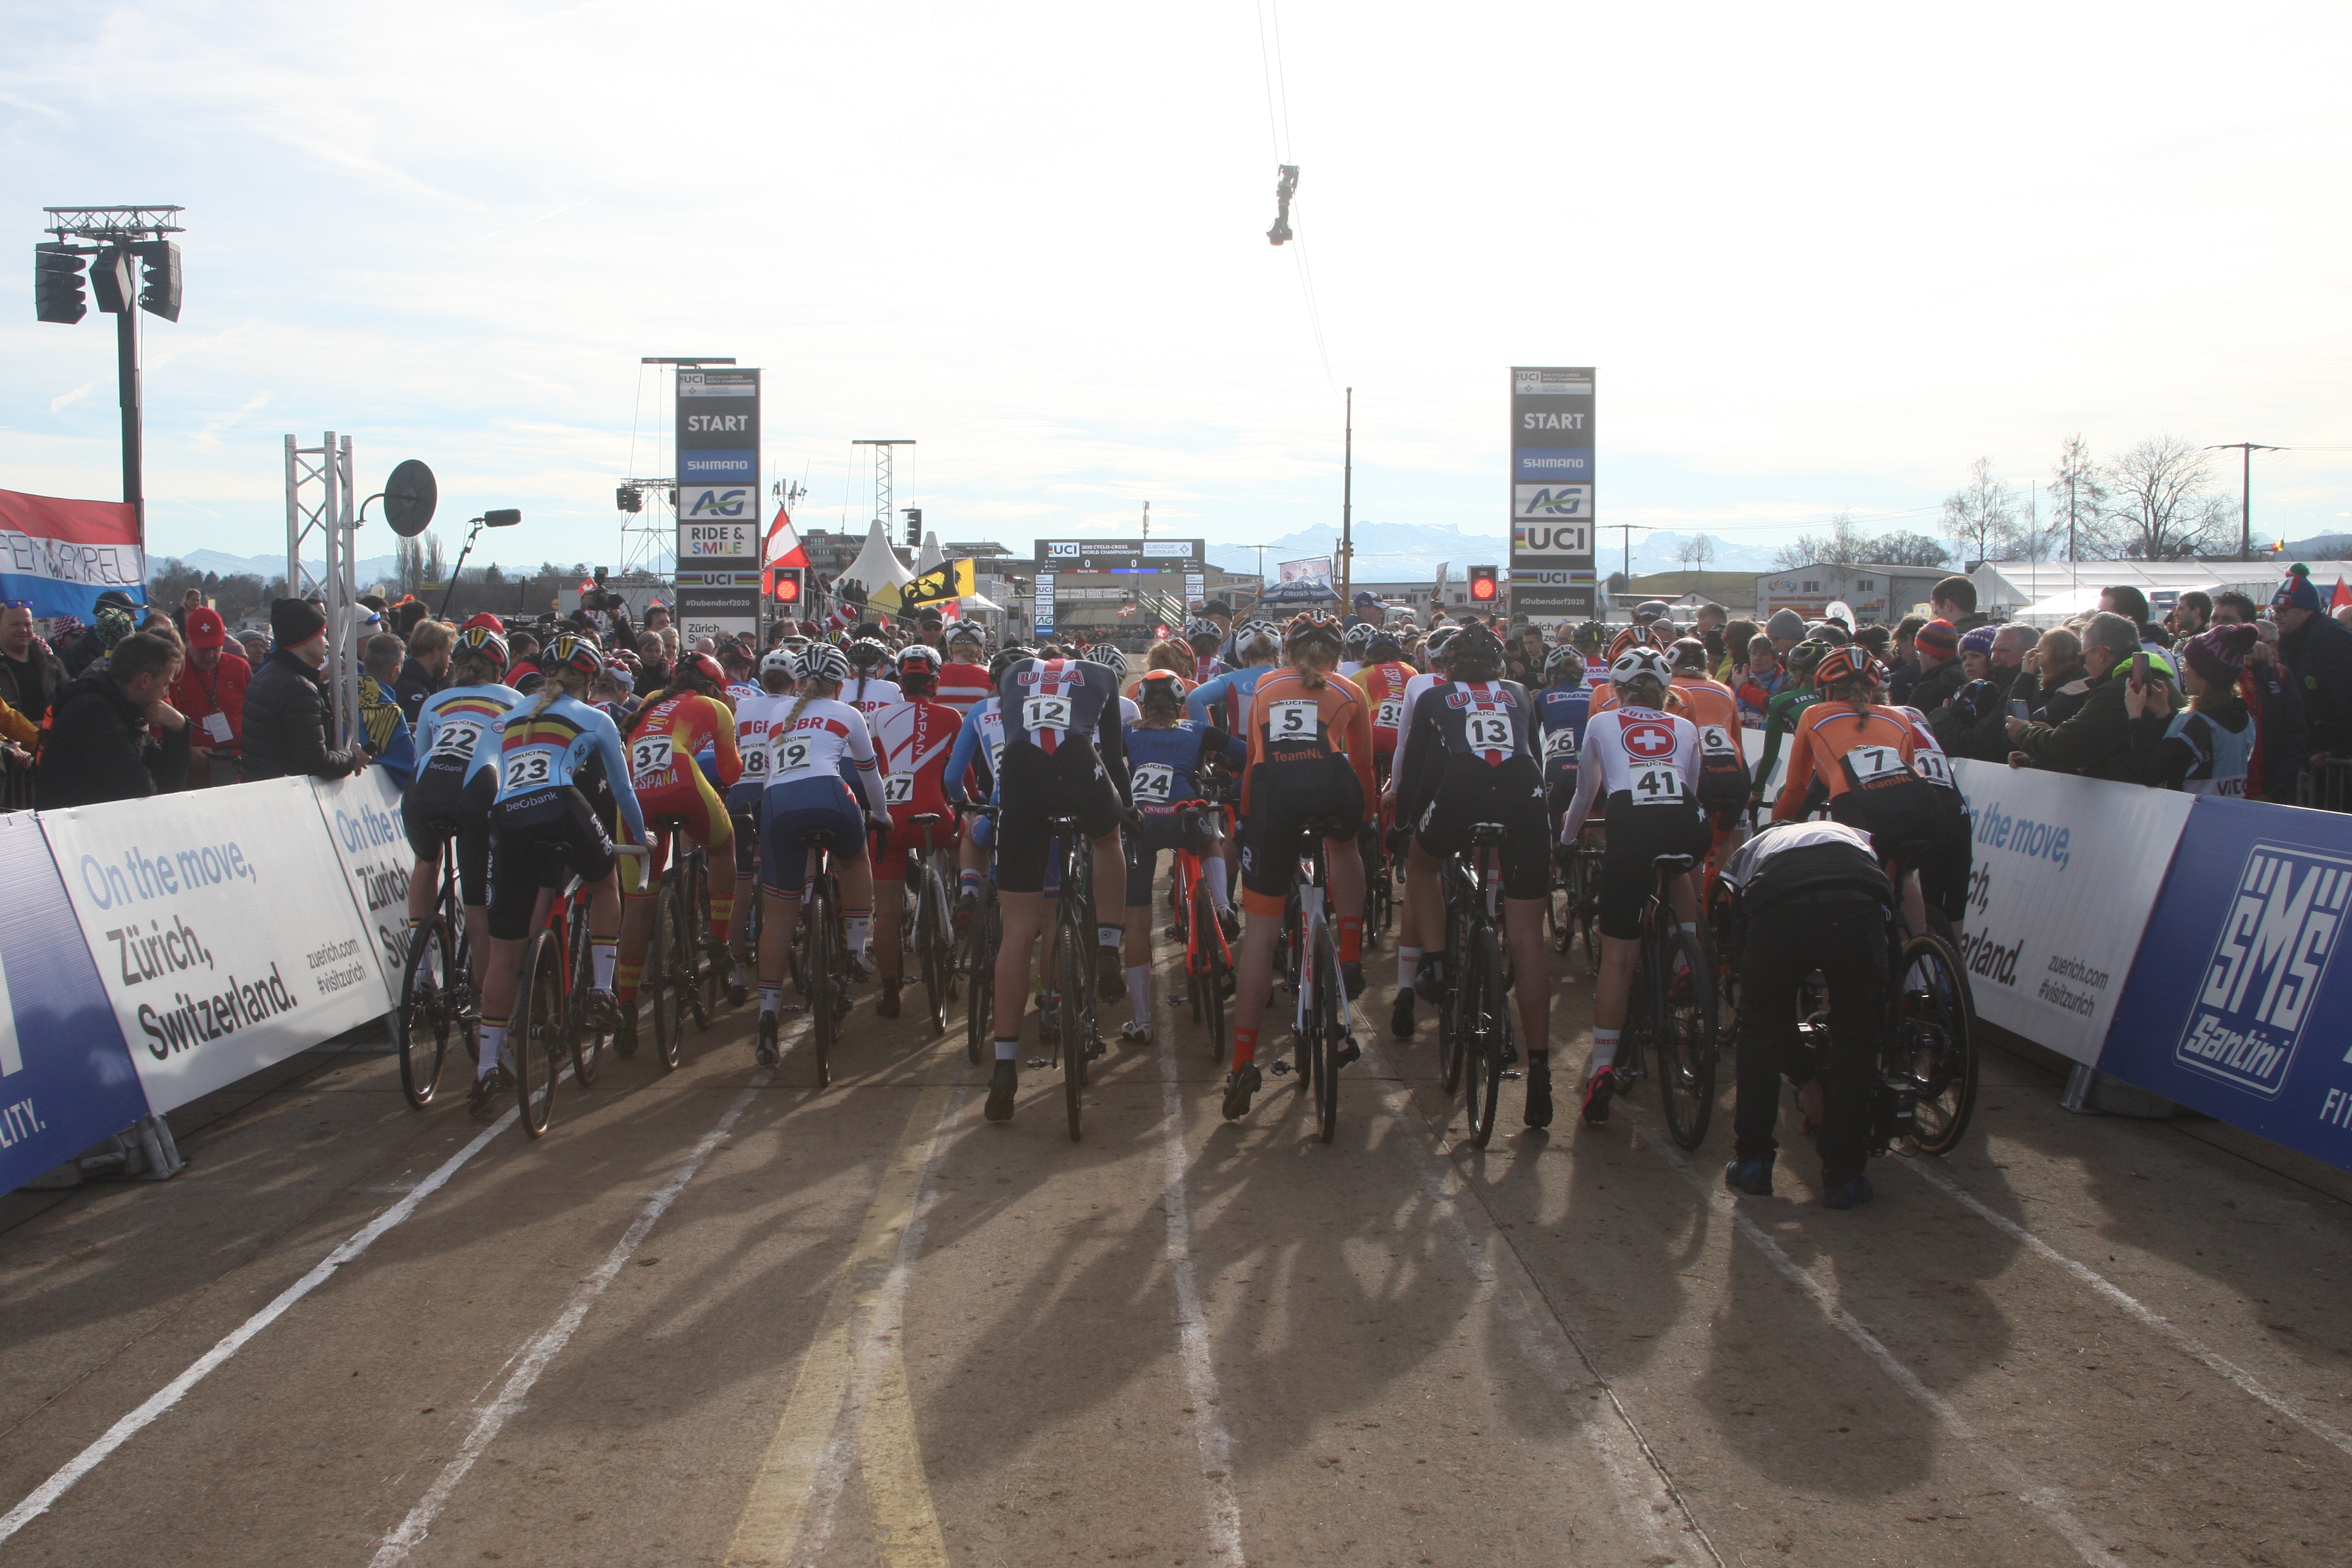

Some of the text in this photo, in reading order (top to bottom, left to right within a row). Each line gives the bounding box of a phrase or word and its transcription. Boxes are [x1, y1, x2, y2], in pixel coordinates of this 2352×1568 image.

[688, 416, 748, 431] START
[1524, 413, 1584, 429] START
[687, 460, 748, 470] SHIMANO
[1523, 459, 1584, 468] SHIMANO
[689, 489, 746, 516] AG
[1524, 488, 1582, 514] AG
[691, 527, 745, 540] RIDE &
[1528, 528, 1584, 549] UCI
[692, 541, 742, 555] SMILE
[1054, 545, 1077, 554] UCI
[704, 574, 731, 585] UCI
[1539, 572, 1566, 584] UCI
[688, 624, 719, 633] Zürich
[1018, 669, 1085, 686] USA
[1198, 665, 1221, 676] SA
[1382, 668, 1405, 698] ESPAÑA
[1445, 690, 1518, 708] USA
[645, 699, 681, 732] ESPAÑA
[1030, 702, 1064, 722] 12
[1282, 709, 1303, 731] 5
[1619, 708, 1671, 719] SUISSE
[436, 728, 477, 752] 22
[915, 704, 929, 755] JAPAN
[1471, 720, 1508, 742] 13
[1704, 728, 1722, 747] 6
[690, 731, 712, 754] ofidis
[1546, 733, 1572, 756] 26
[636, 743, 670, 768] 37
[741, 751, 763, 772] 18
[777, 745, 806, 769] 19
[1272, 748, 1324, 762] TeamNL
[1864, 750, 1884, 771] 7
[508, 759, 547, 786] 23
[1917, 756, 1944, 779] 11
[885, 779, 912, 800] 47
[1132, 773, 1169, 795] 24
[1637, 770, 1675, 795] 41
[1858, 774, 1913, 790] TeamNL
[336, 809, 368, 854] On
[361, 805, 394, 846] the
[1978, 802, 2011, 849] the
[2008, 818, 2069, 872] move,
[80, 842, 256, 910] On the move,
[106, 915, 214, 986] Zürich,
[307, 938, 361, 970] zuerich.com
[2201, 855, 2352, 1031] SMS
[1961, 927, 2024, 987] erland.
[316, 963, 367, 996] #visitzurich
[2047, 955, 2109, 990] zuerich.com
[2037, 978, 2094, 1018] #visitzurich
[138, 961, 298, 1060] Switzerland.
[2184, 1013, 2290, 1079] Santini
[0, 1096, 46, 1148] LITY.
